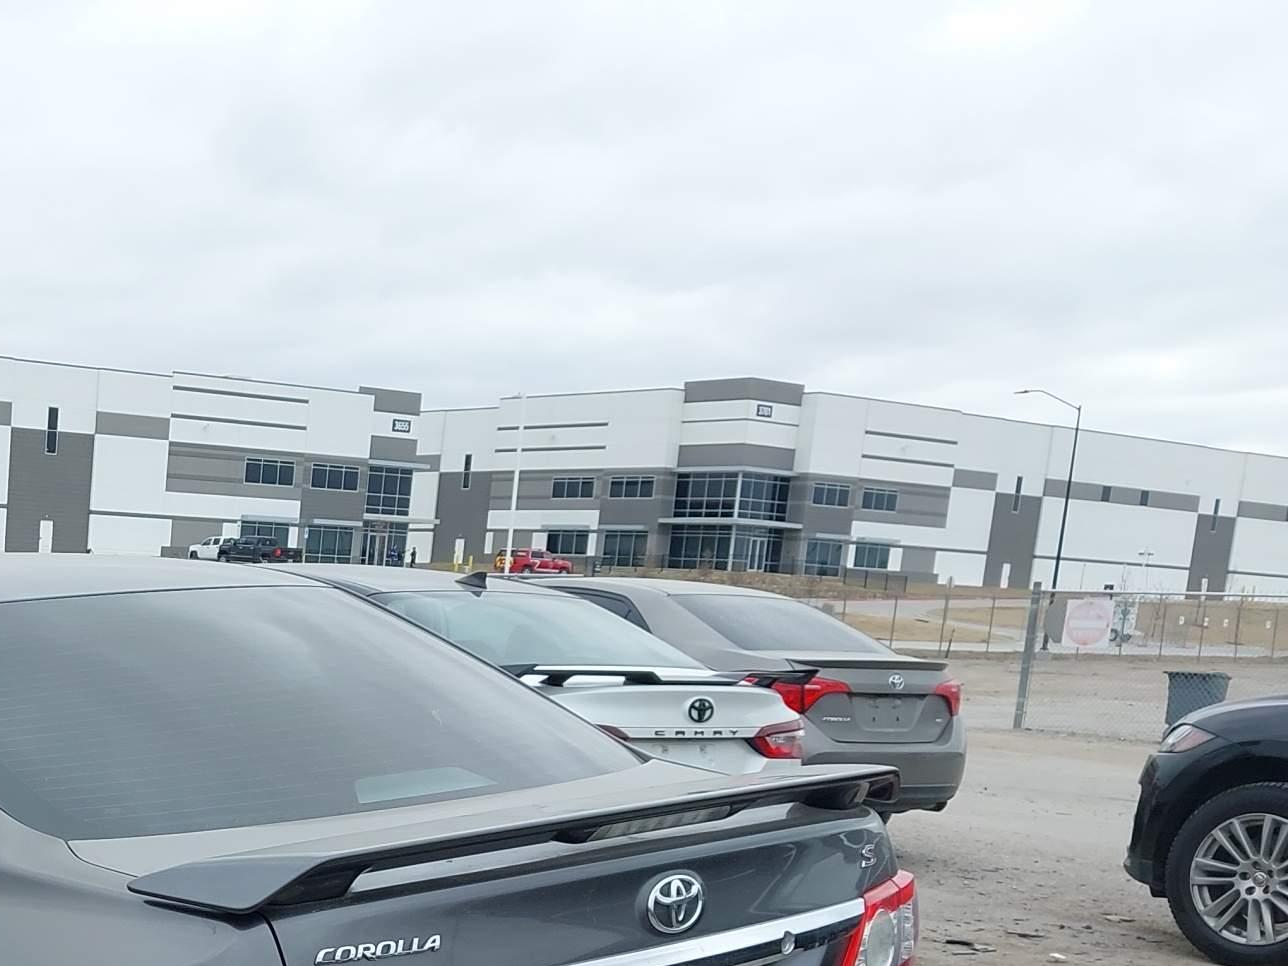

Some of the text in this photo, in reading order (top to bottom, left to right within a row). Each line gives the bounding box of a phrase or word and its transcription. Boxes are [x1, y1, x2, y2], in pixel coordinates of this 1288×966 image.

[654, 729, 738, 737] CAMRY
[861, 844, 877, 868] S
[314, 934, 441, 965] COROLLA
